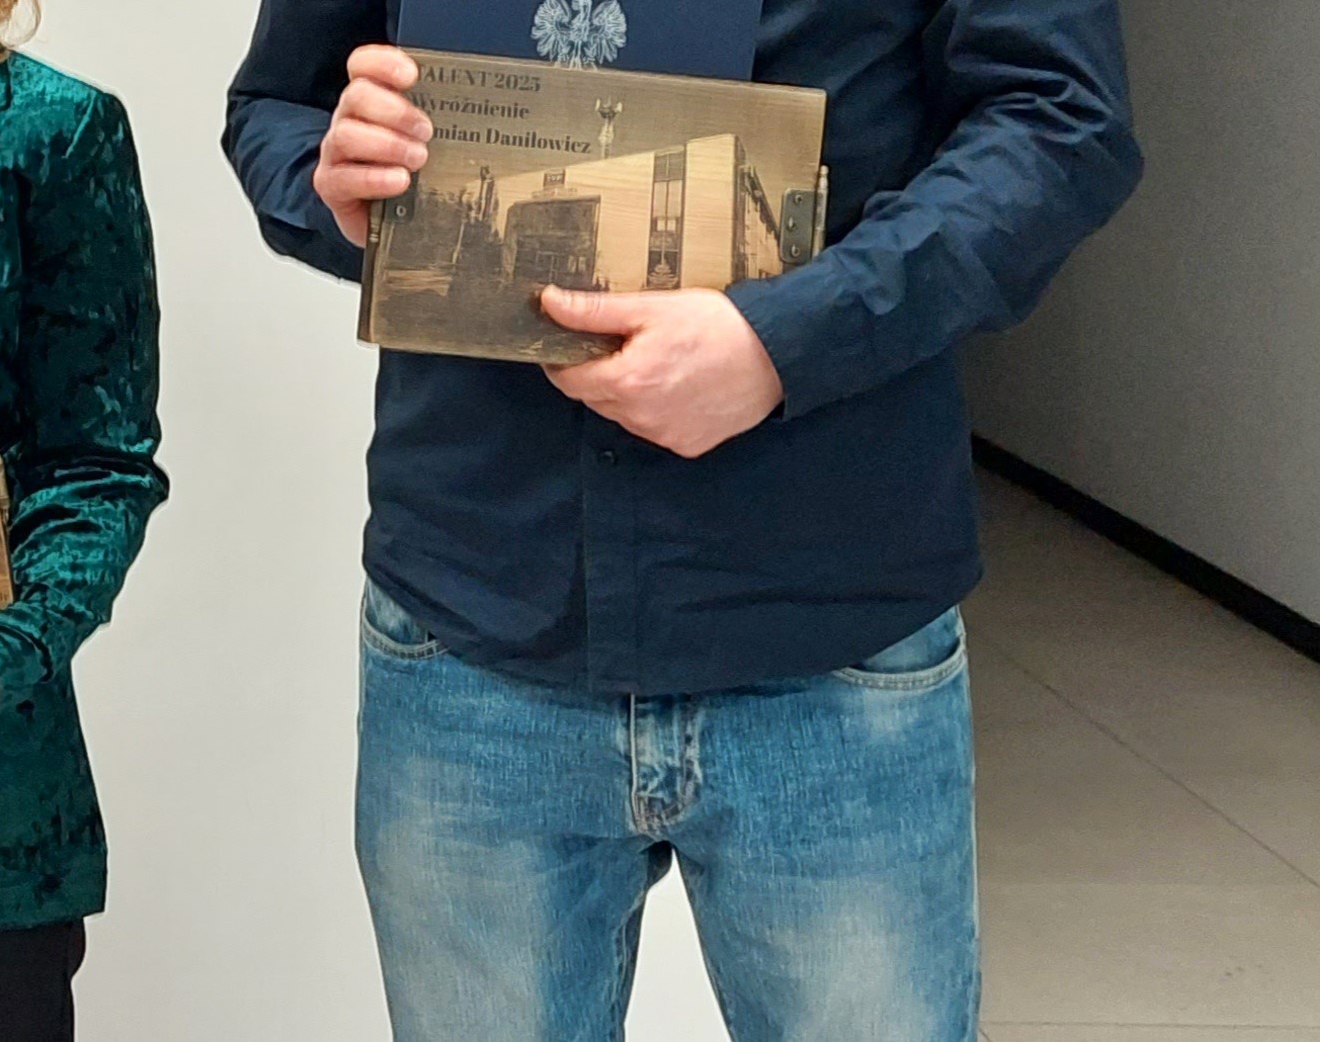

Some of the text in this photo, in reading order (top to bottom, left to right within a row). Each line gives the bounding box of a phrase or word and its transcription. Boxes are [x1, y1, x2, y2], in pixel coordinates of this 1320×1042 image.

[417, 64, 541, 92] TALENT 2025
[432, 124, 480, 144] mian
